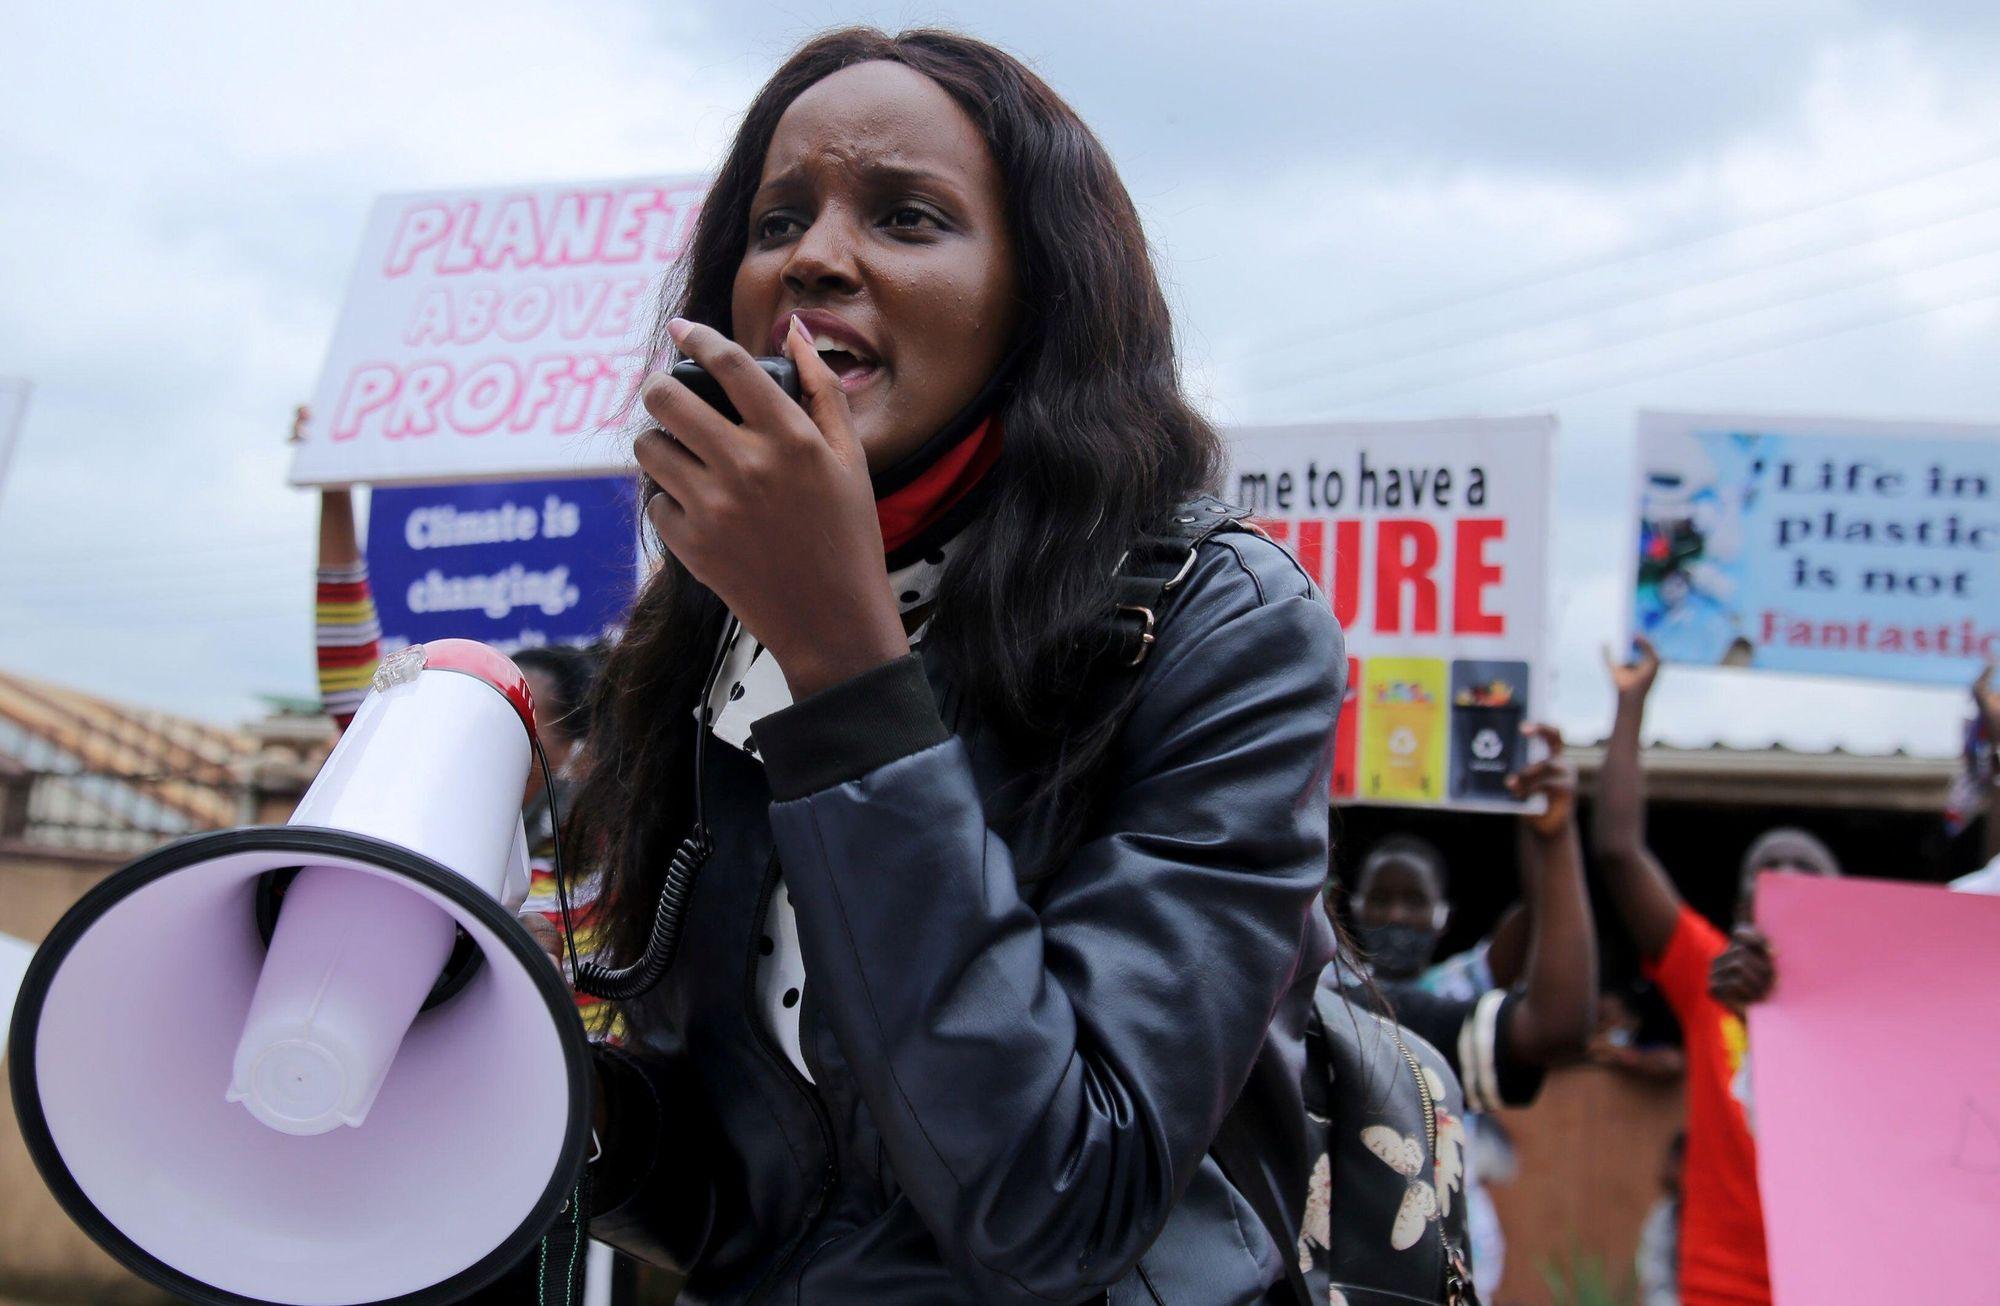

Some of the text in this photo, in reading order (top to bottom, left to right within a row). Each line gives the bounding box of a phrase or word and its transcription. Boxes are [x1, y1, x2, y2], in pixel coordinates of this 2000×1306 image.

[384, 185, 706, 278] PLANET
[405, 280, 646, 346] ABOVE
[1238, 451, 1486, 510] me to have a
[1928, 466, 1987, 497] in
[405, 494, 580, 550] Climate is
[1776, 510, 1998, 548] plastic
[1252, 518, 1505, 635] URE
[1793, 555, 1970, 599] is not
[1760, 609, 2000, 658] Fantastic
